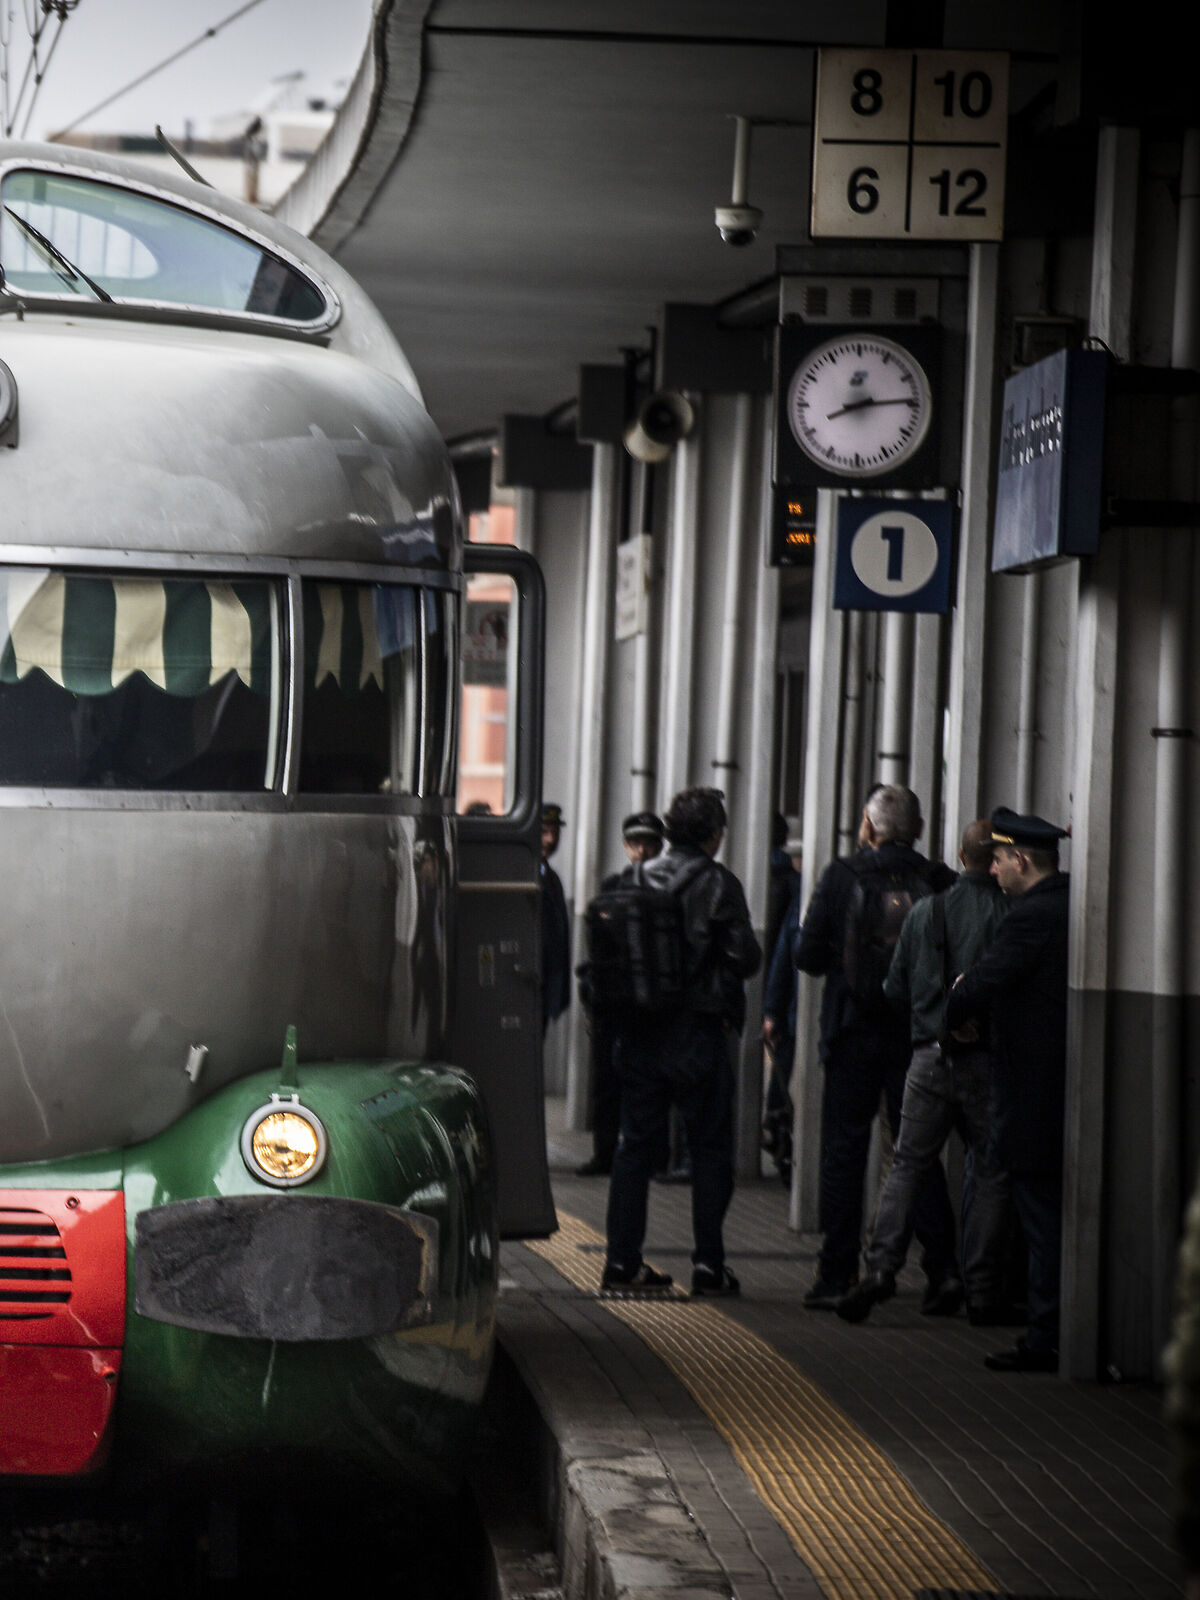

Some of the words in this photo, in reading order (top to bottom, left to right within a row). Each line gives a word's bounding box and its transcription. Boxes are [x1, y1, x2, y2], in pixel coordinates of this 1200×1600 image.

[851, 68, 883, 116] 8
[934, 70, 992, 118] 10
[847, 166, 880, 214] 6
[929, 169, 988, 217] 12
[881, 526, 904, 582] 1
